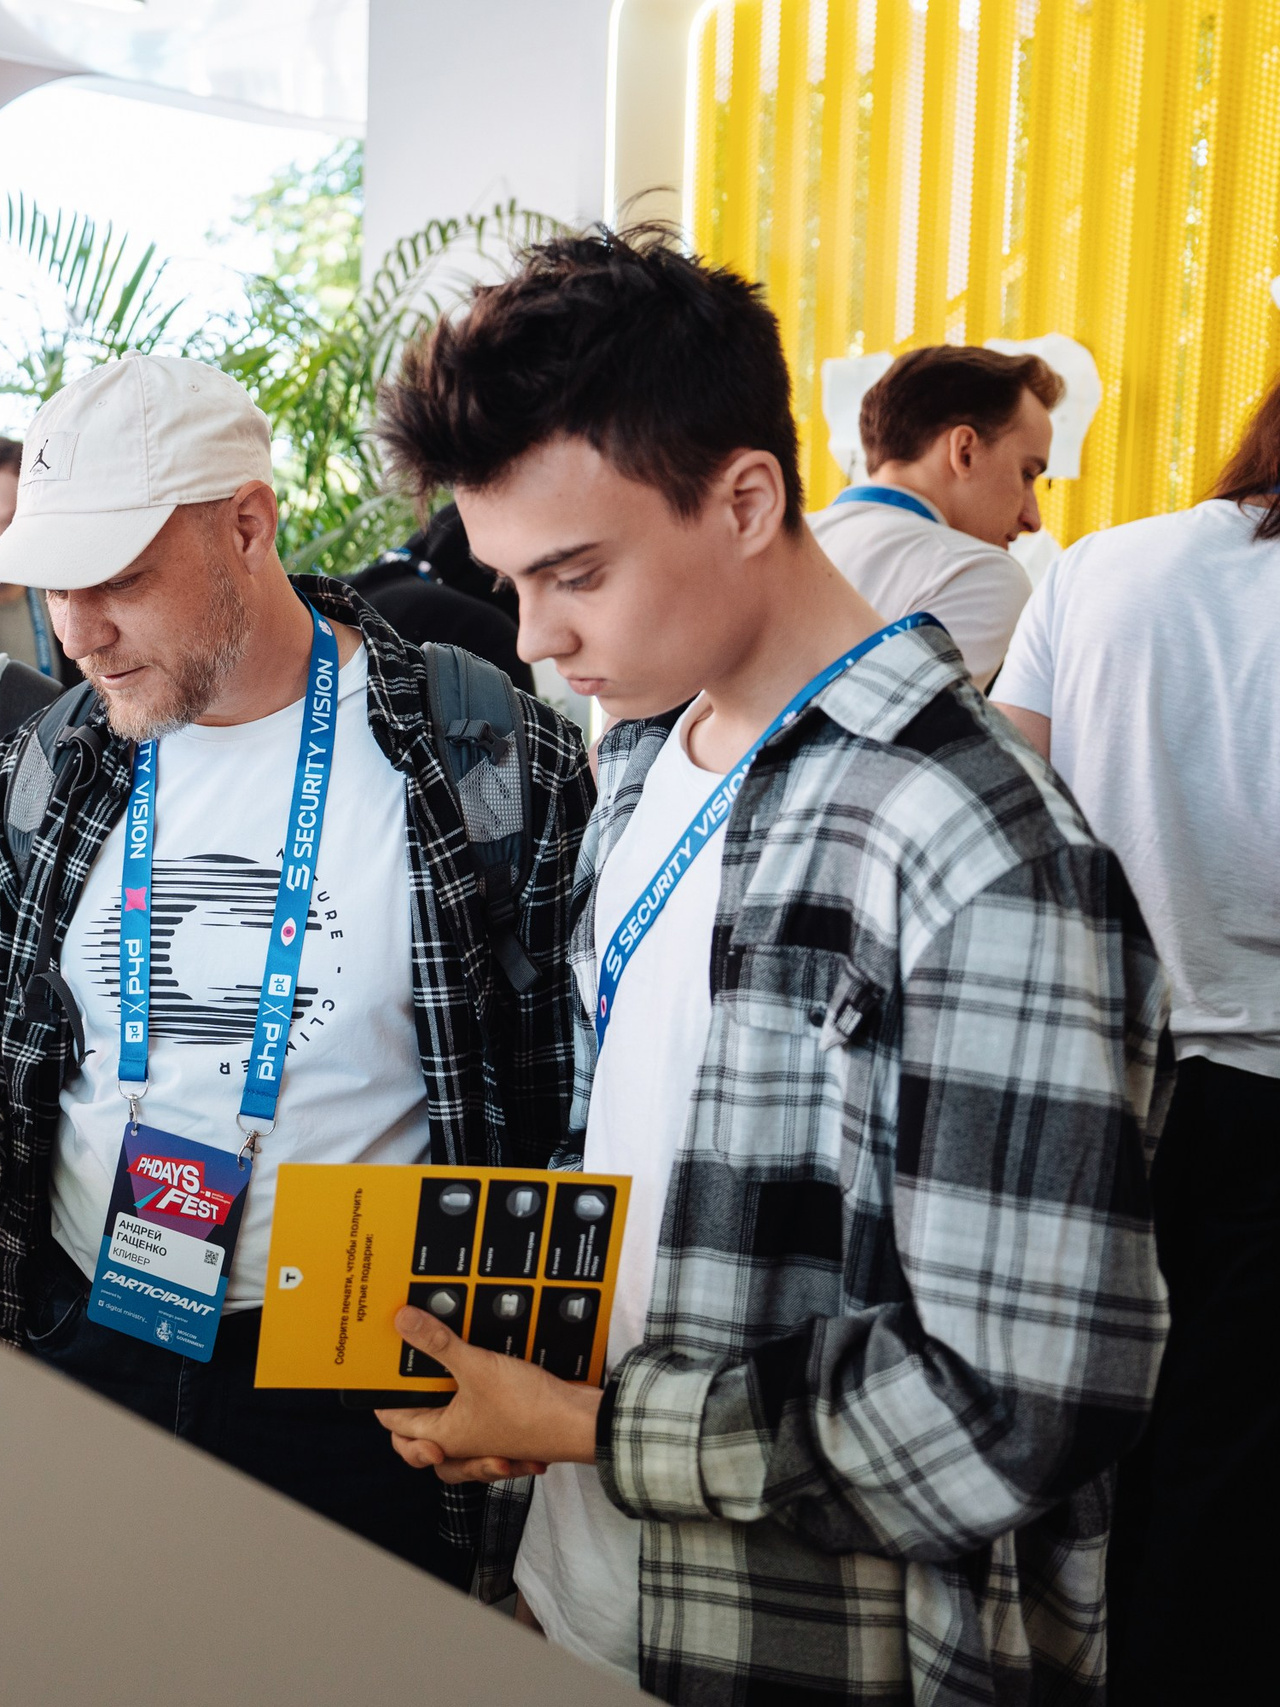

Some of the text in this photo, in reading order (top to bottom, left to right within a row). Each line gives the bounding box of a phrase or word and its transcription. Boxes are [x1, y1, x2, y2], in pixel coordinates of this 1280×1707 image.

[293, 658, 334, 859] SECURITY VISION
[130, 780, 150, 859] VISION
[618, 754, 756, 954] SECURITY VISIO
[220, 999, 336, 1075] CLIMER
[137, 1157, 200, 1194] PHDAYS
[155, 1188, 219, 1220] FEST
[116, 1232, 167, 1256] ГАЩЕНКО
[119, 1220, 162, 1241] АНДРЕЙ
[113, 1247, 150, 1265] КЛИВЕР
[100, 1289, 116, 1298] powered
[102, 1270, 215, 1316] PARTICIPANT
[335, 1188, 363, 1366] Соберите печати, чтобы получить
[357, 1234, 374, 1323] крутые подарки:
[105, 1303, 123, 1314] digital
[176, 1335, 205, 1349] GOVERNMENT
[177, 1329, 198, 1340] MOSCOW
